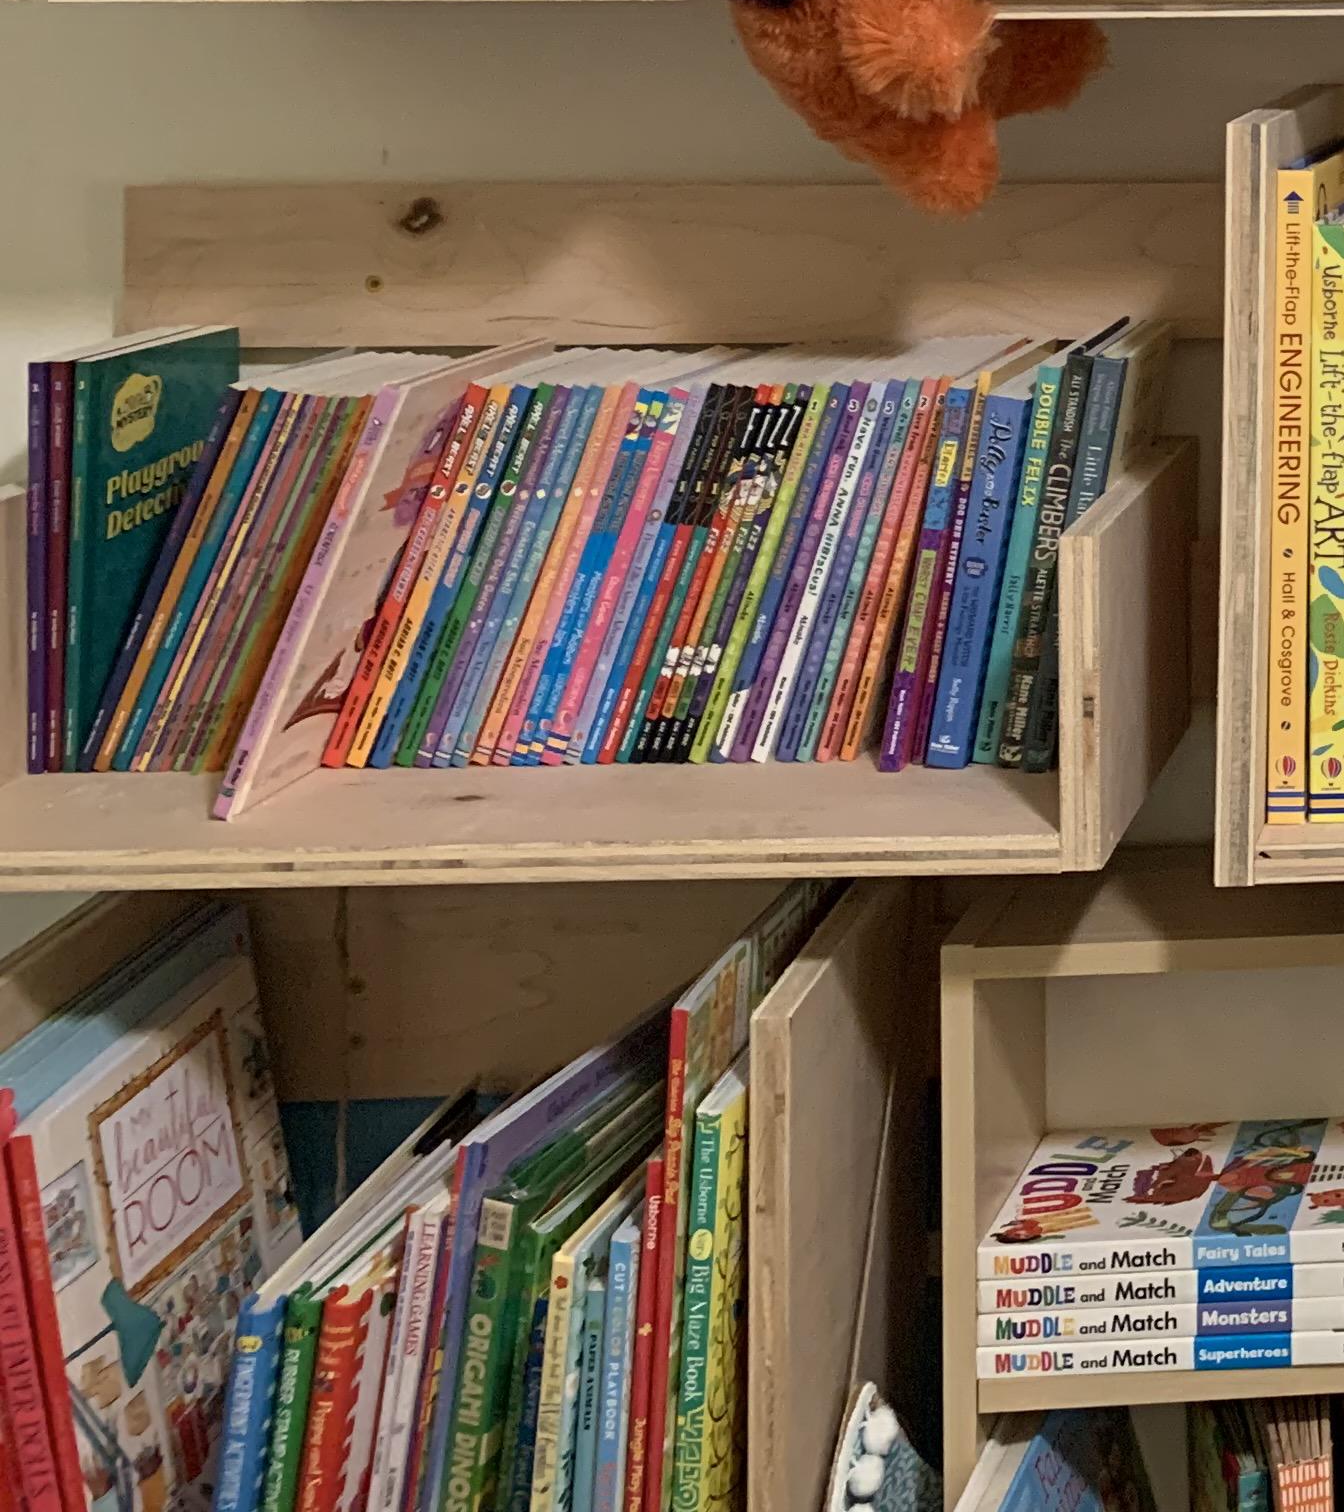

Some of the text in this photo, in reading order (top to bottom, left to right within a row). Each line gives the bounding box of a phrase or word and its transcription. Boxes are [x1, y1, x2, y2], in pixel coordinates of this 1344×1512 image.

[1277, 333, 1303, 526] ENGINEERING
[1034, 464, 1072, 563] CLIMBERS
[994, 1247, 1176, 1275] MUDDLE and Match
[1203, 1275, 1287, 1293] Adventure
[1202, 1307, 1287, 1326] Monsters
[1199, 1345, 1289, 1364] Superheroes
[460, 1313, 492, 1426] ORIGAMI
